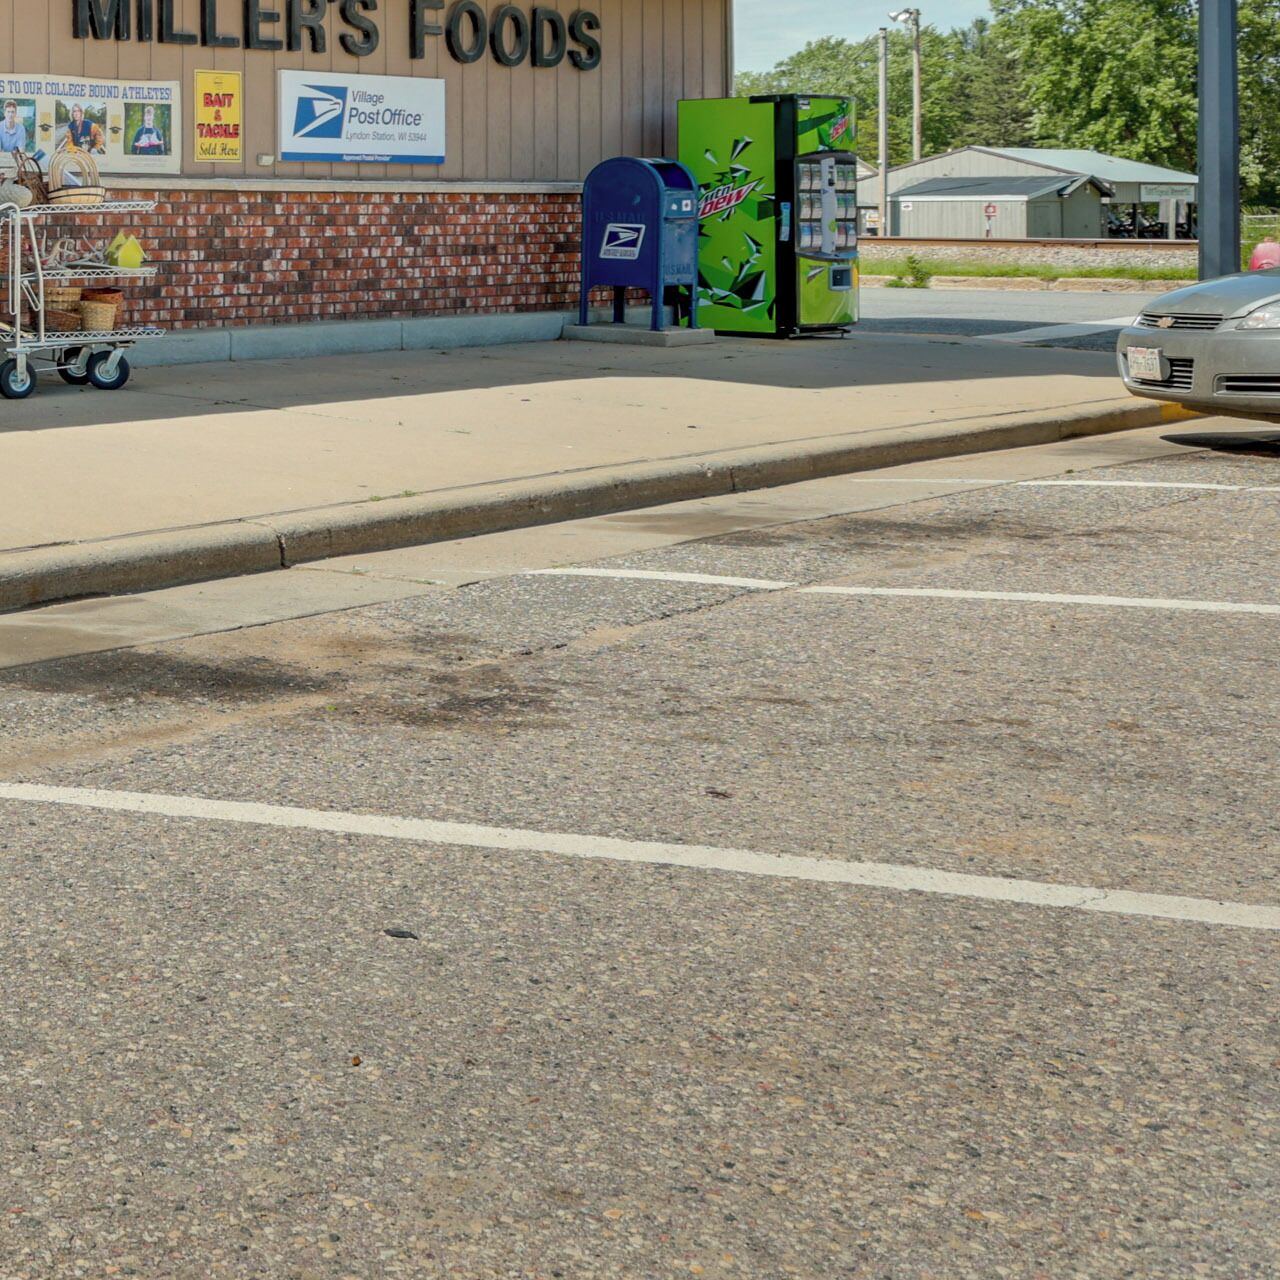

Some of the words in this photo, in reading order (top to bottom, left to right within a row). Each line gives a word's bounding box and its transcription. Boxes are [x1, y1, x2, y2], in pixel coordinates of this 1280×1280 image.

[8, 81, 21, 94] TO
[23, 81, 44, 95] OUR
[45, 82, 87, 98] COLLEGE
[88, 84, 119, 99] BOUND
[122, 86, 173, 101] ATHLETES!
[351, 90, 384, 105] Village
[203, 93, 234, 108] BAIT
[214, 109, 222, 121] &
[348, 107, 380, 125] Post
[380, 108, 422, 126] Office
[197, 123, 240, 139] TACKLE
[345, 130, 370, 142] Lyndon
[372, 131, 396, 142] Station,
[199, 142, 218, 156] Sold
[220, 143, 239, 157] Here
